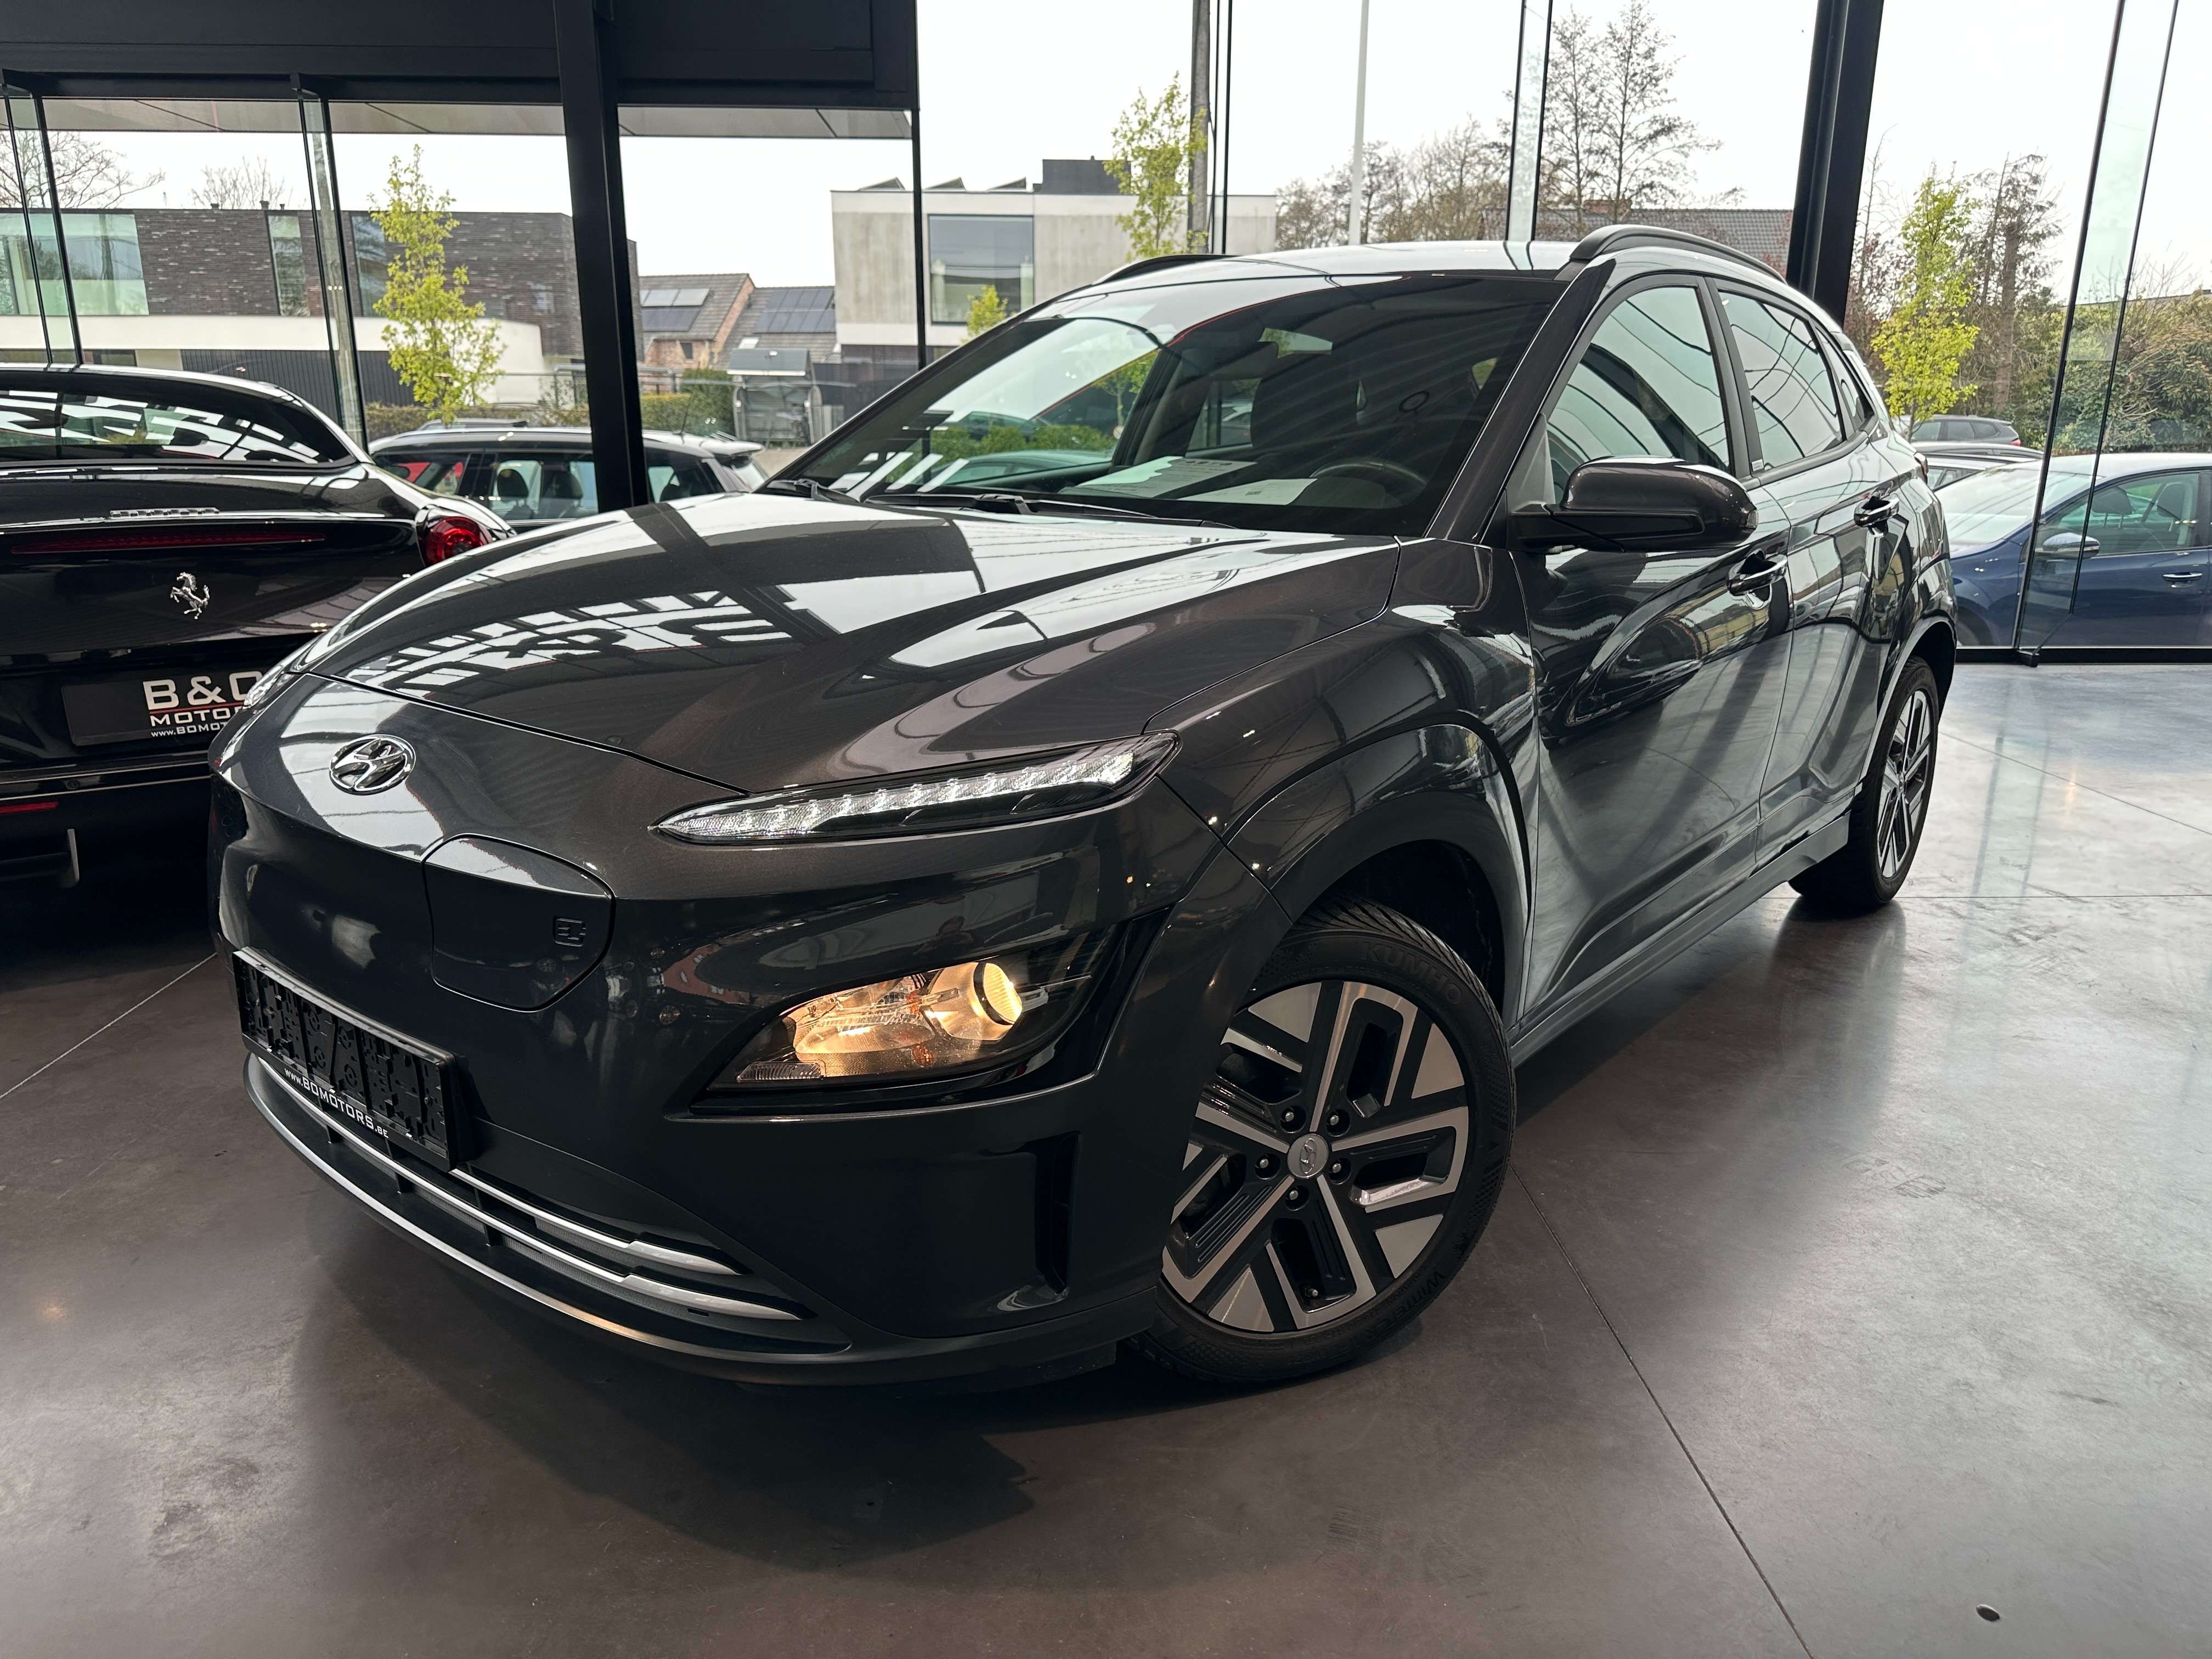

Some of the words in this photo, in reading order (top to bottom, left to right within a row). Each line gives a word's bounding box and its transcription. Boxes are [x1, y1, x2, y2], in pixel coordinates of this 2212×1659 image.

[150, 707, 241, 727] MOTO
[1361, 940, 1462, 1005] KUMHO
[284, 1068, 389, 1139] www.BOMOTORS.BE
